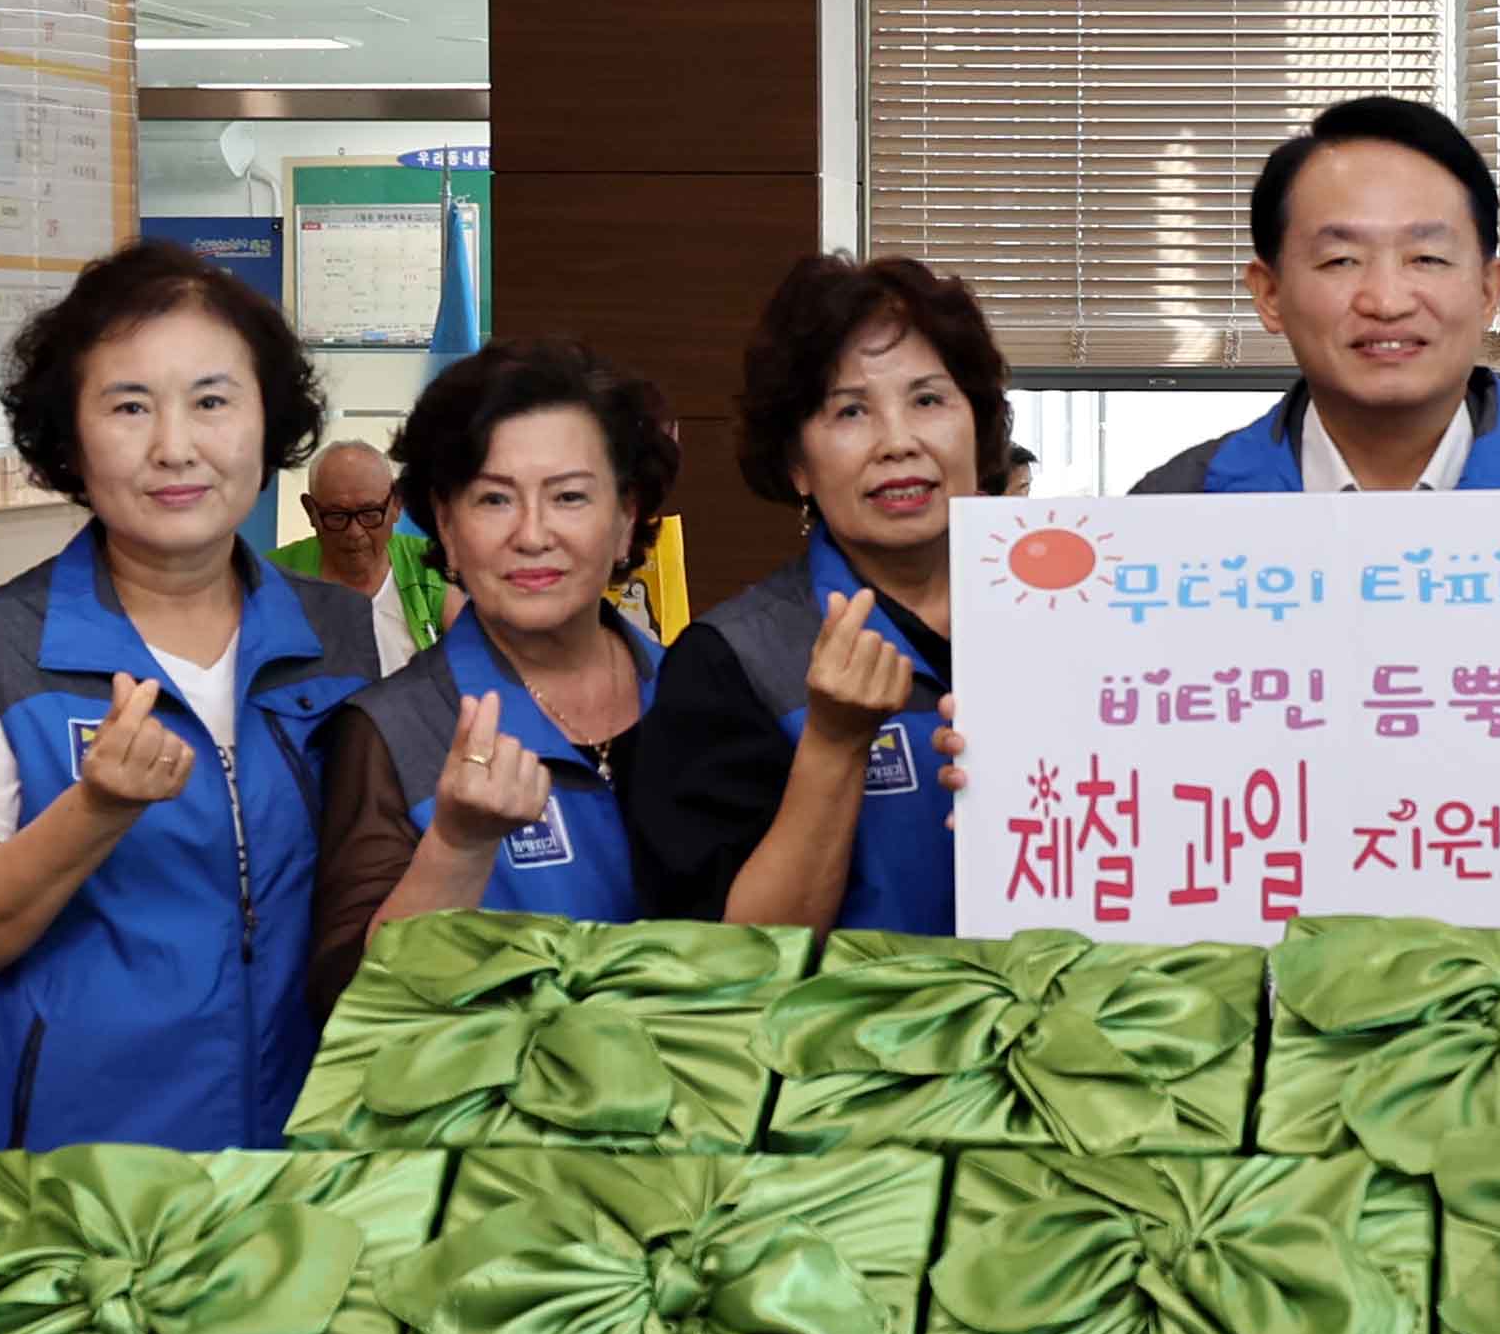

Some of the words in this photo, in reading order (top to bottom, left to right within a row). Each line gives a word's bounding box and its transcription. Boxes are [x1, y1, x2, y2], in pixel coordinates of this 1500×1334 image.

[1108, 555, 1324, 623] 무더위
[1100, 668, 1328, 730] 비타민
[1006, 753, 1140, 923] 제철
[1168, 758, 1309, 923] 과일
